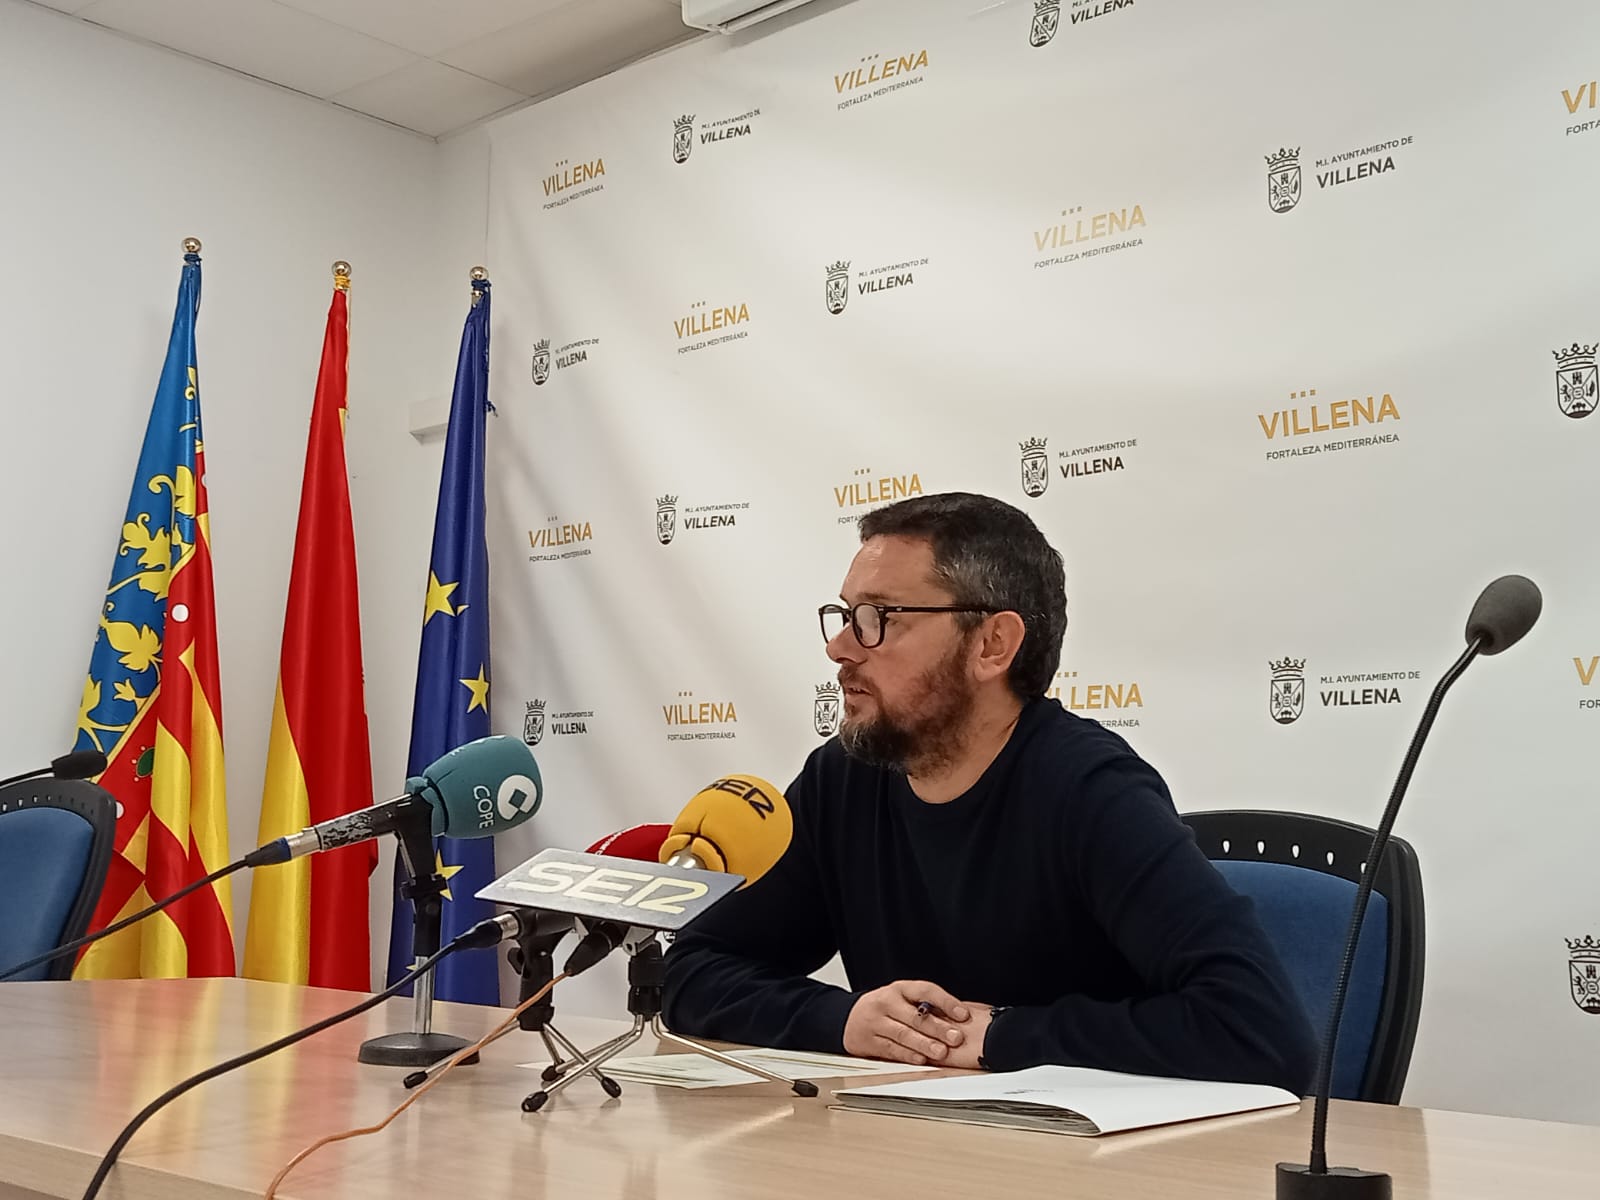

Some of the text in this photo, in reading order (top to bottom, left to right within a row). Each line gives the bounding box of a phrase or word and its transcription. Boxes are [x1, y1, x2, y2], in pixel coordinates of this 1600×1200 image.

[834, 49, 928, 94] VILLENA
[837, 93, 872, 111] FORTALEZA
[700, 124, 751, 145] VILLENA
[1331, 139, 1400, 165] AYUNTAMIENTO
[1401, 136, 1413, 146] DE
[542, 158, 605, 197] VILLENA
[1316, 156, 1396, 189] VILLENA
[1034, 205, 1147, 252] VILLENA
[870, 260, 919, 276] AYUNTAMIENTO
[920, 258, 929, 266] DE
[1034, 238, 1144, 269] FORTALEZA MEDITERRÁNEA
[858, 272, 914, 295] VILLENA
[674, 303, 750, 339] VILLENA
[555, 350, 587, 370] VILLENA
[1258, 393, 1401, 440] VILLENA
[1071, 441, 1126, 457] AYUNTAMIENTO
[1127, 439, 1137, 447] DE
[1266, 433, 1400, 461] FORTALEZA MEDITERRÁNEA
[1060, 455, 1125, 479] VILLENA
[834, 473, 923, 508] VILLENA
[528, 521, 593, 548] VILLENA
[684, 514, 736, 530] VILLENA
[1336, 672, 1406, 684] AYUNTAMIENTO
[1408, 671, 1421, 680] DE
[1320, 688, 1402, 707] VILLENA
[662, 702, 737, 726] VILLENA
[551, 721, 588, 735] VILLENA
[473, 785, 495, 829] COPE
[506, 861, 709, 915] SER
